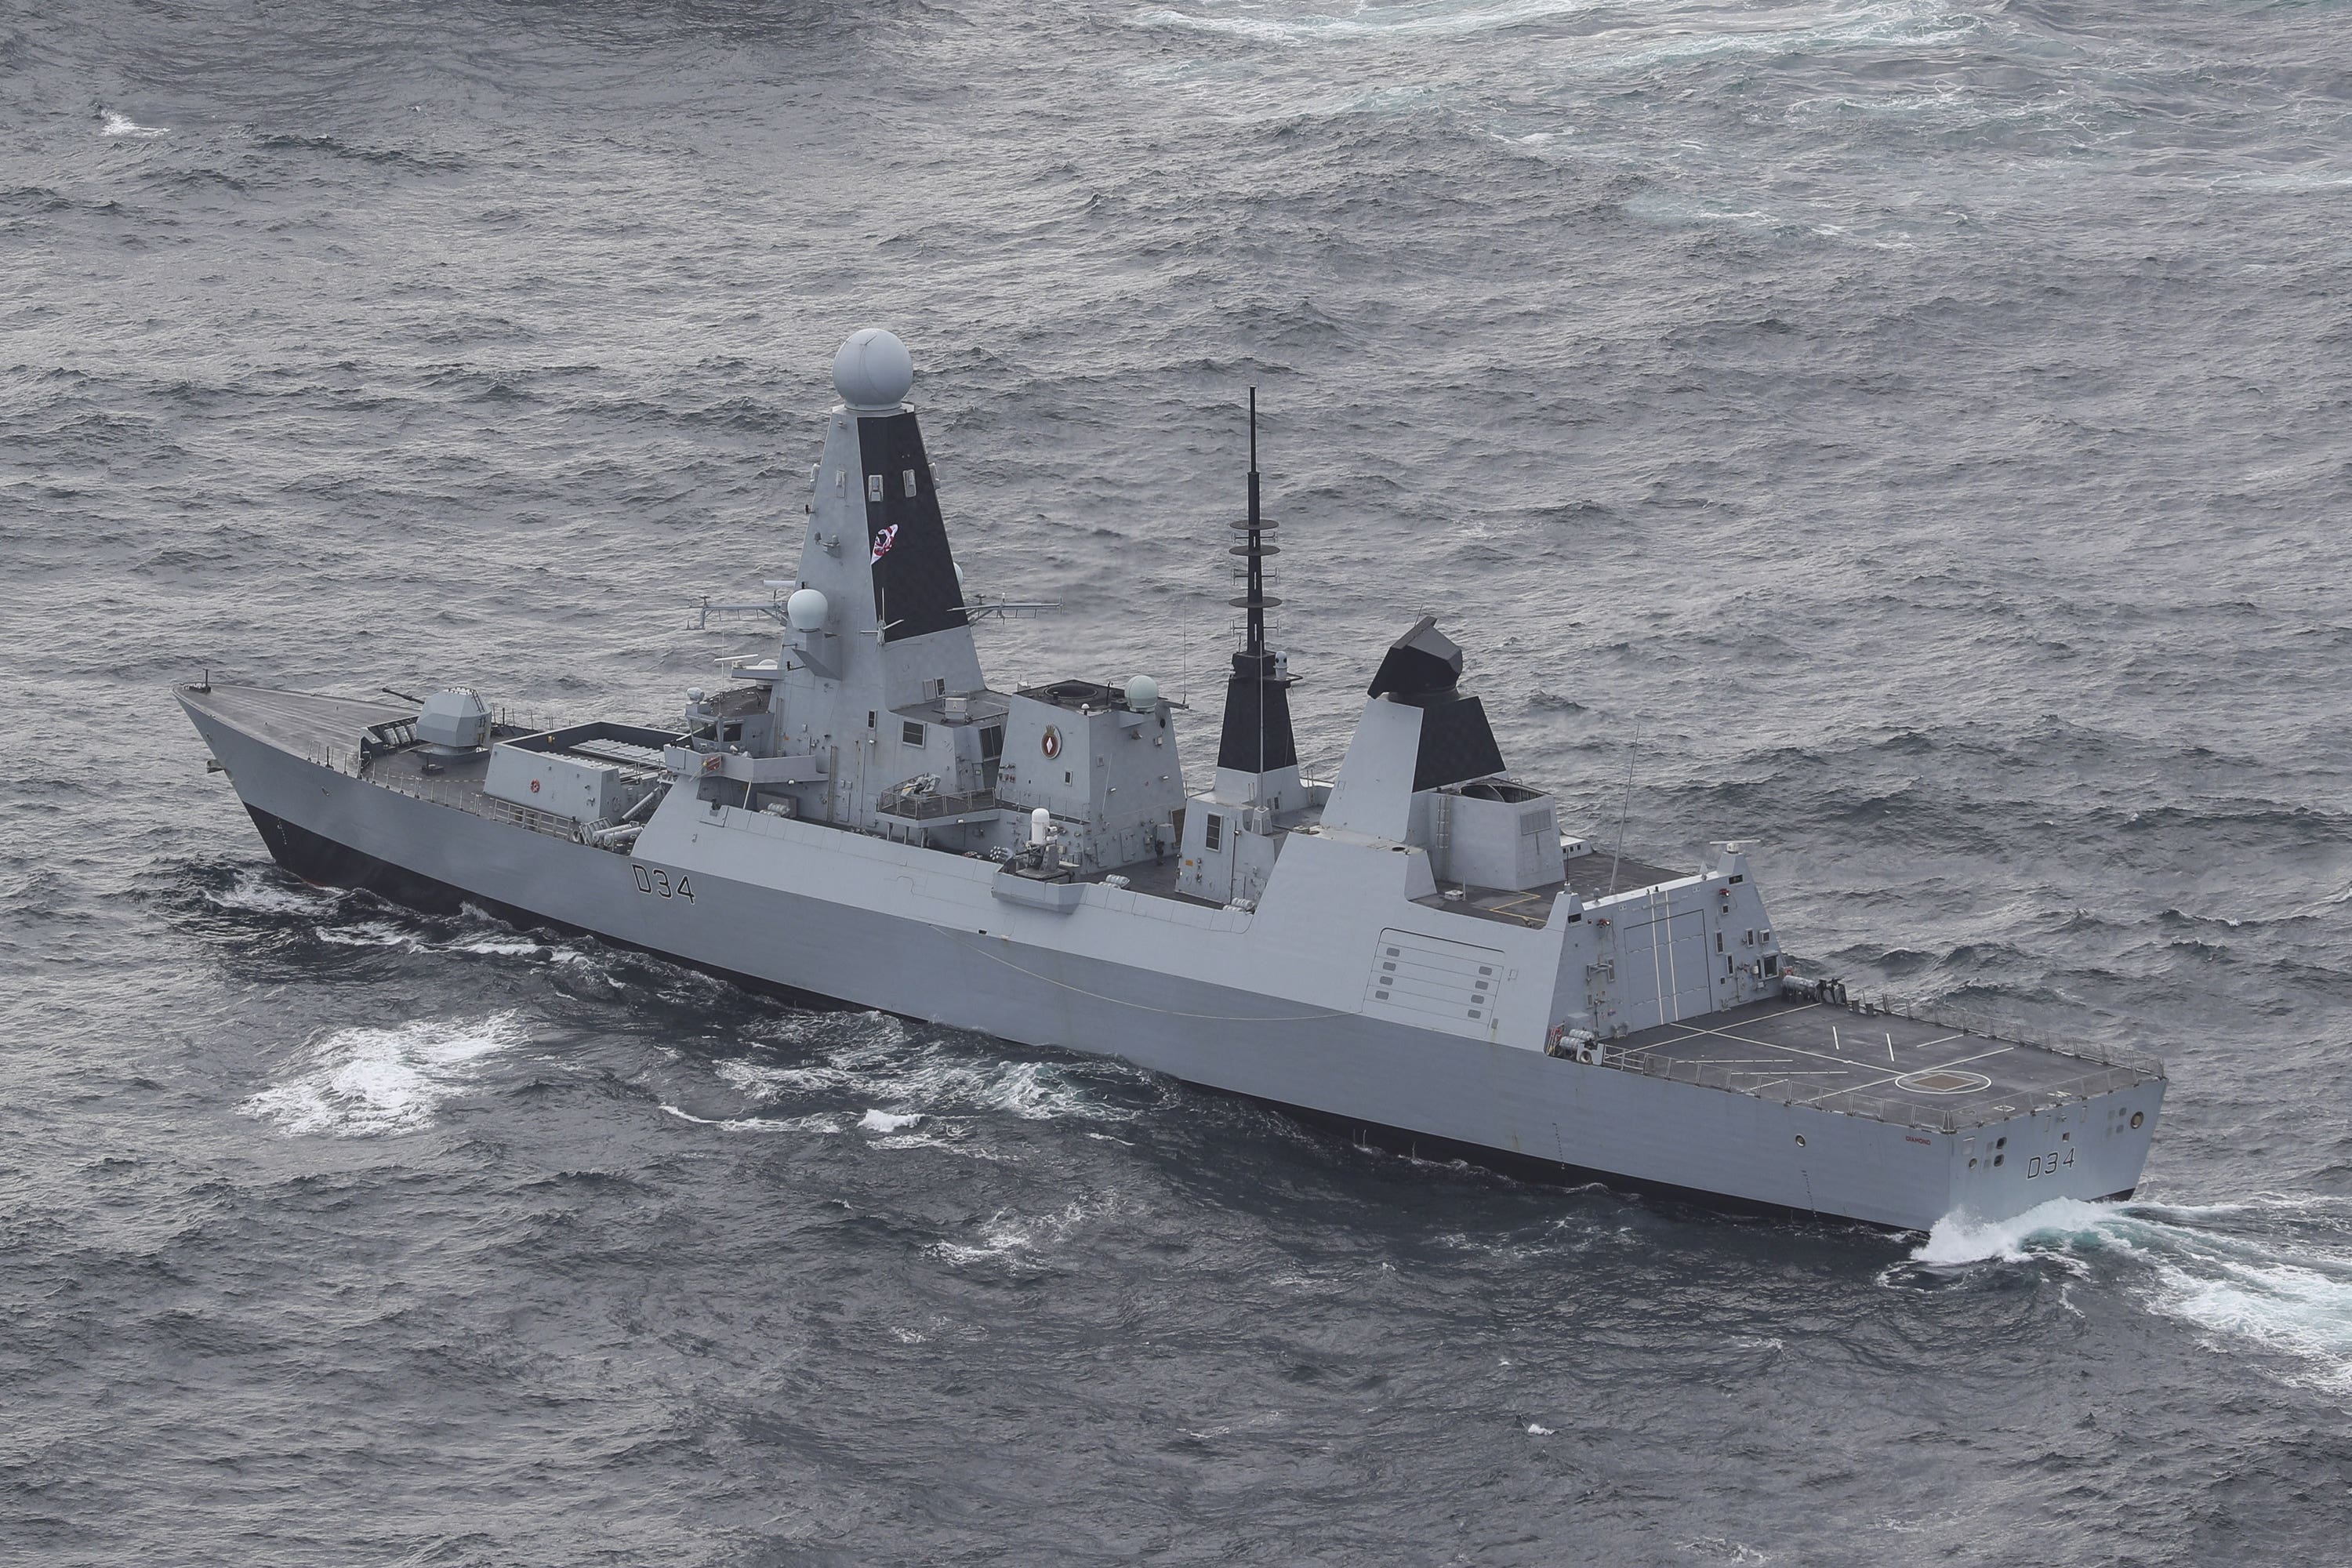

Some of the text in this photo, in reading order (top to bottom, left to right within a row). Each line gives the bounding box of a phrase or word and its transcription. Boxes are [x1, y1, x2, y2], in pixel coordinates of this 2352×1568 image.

[631, 863, 695, 905] D34
[1905, 1135, 1931, 1145] DIAMOND
[2027, 1147, 2075, 1180] D34
